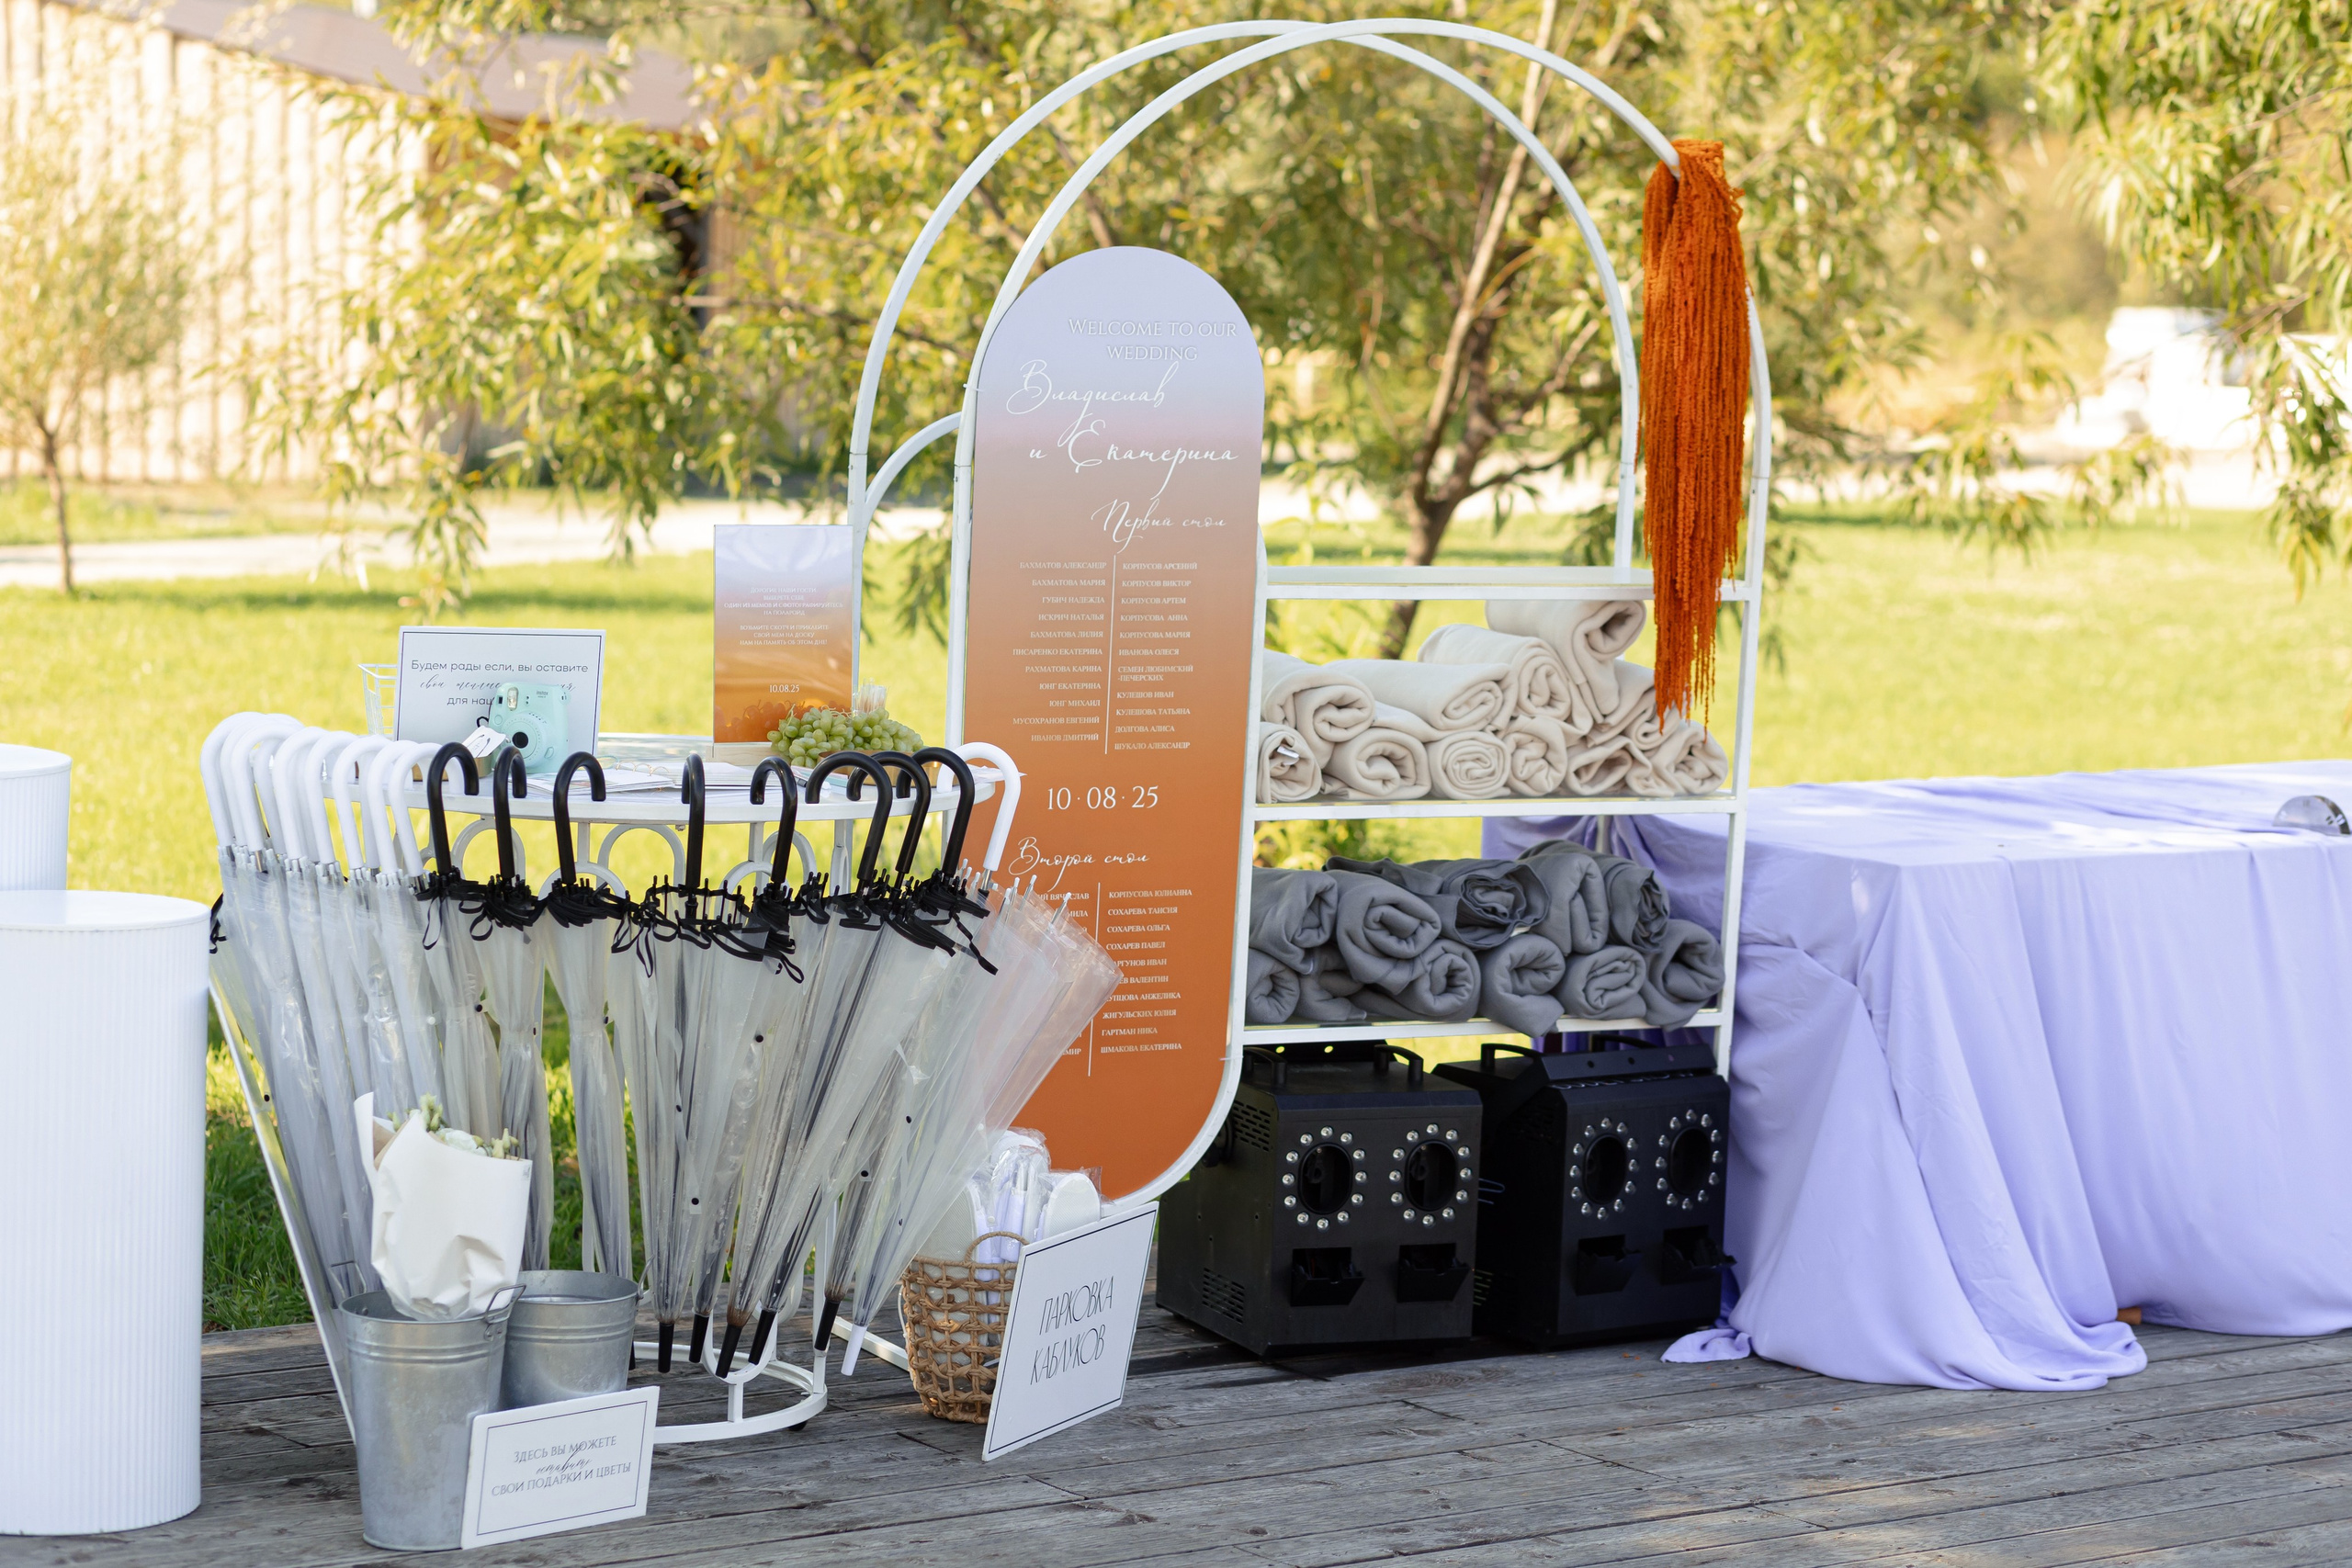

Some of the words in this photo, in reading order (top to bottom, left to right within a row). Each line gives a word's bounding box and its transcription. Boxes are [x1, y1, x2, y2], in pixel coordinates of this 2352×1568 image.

[1107, 346, 1198, 360] WEDDING
[1006, 359, 1179, 447] Владислав
[1029, 449, 1047, 459] и
[1068, 420, 1238, 500] Екатерина
[1091, 498, 1174, 555] Первый
[1182, 517, 1227, 527] стол
[412, 660, 447, 672] Будем
[450, 664, 481, 672] рады
[485, 664, 514, 672] если,
[769, 684, 800, 693] 10.08.25
[447, 698, 468, 706] для
[1063, 733, 1099, 741] ДМИТРИЙ
[1008, 836, 1095, 893] Второй
[1104, 852, 1150, 864] стол
[1130, 976, 1169, 984] ВАЛЕНТИН
[1107, 994, 1138, 1002] УПЦОВА
[1140, 992, 1182, 1000] АНЖЕЛИКА
[1102, 1010, 1153, 1020] ЖИГУЛЬСКИХ
[1101, 1045, 1138, 1054] ШМАКОВА
[1139, 1043, 1182, 1052] ЕКАТЕРИНА
[1039, 1276, 1114, 1336] ПАРКОВКА
[1030, 1324, 1106, 1385] КАБЛУКОВ
[514, 1449, 548, 1463] ЗДЕСЬ
[551, 1445, 565, 1455] ВЫ
[570, 1436, 617, 1453] МОЖЕТЕ
[492, 1483, 524, 1496] СВОИ
[527, 1472, 582, 1490] ПОДАРКИ
[584, 1470, 594, 1481] И
[596, 1462, 631, 1478] ЦВЕТЫ
